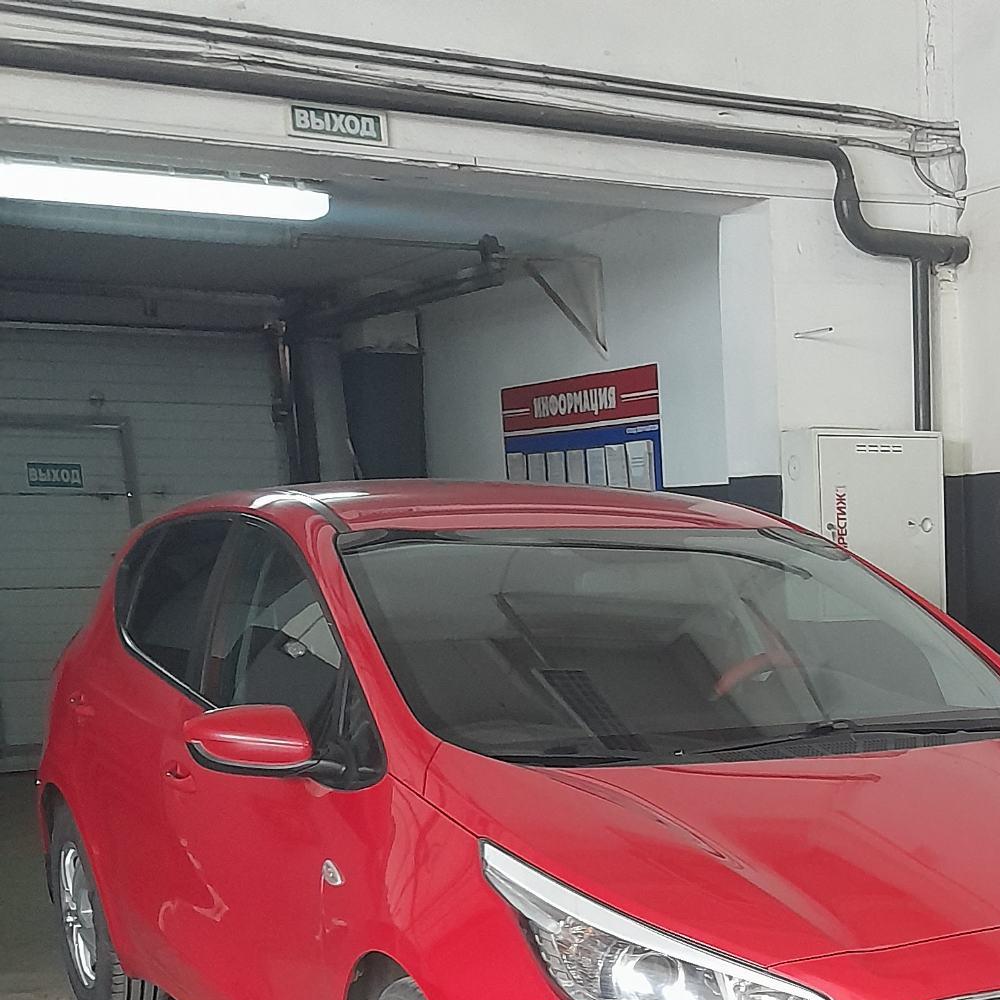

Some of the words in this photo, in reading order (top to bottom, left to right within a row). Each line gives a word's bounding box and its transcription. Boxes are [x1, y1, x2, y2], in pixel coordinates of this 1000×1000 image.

[294, 108, 377, 138] ВЫХОД
[534, 386, 616, 419] ИНФОРМАЦИЯ
[29, 467, 81, 486] ВЫХОД
[835, 491, 848, 548] РЕСТИЖ
